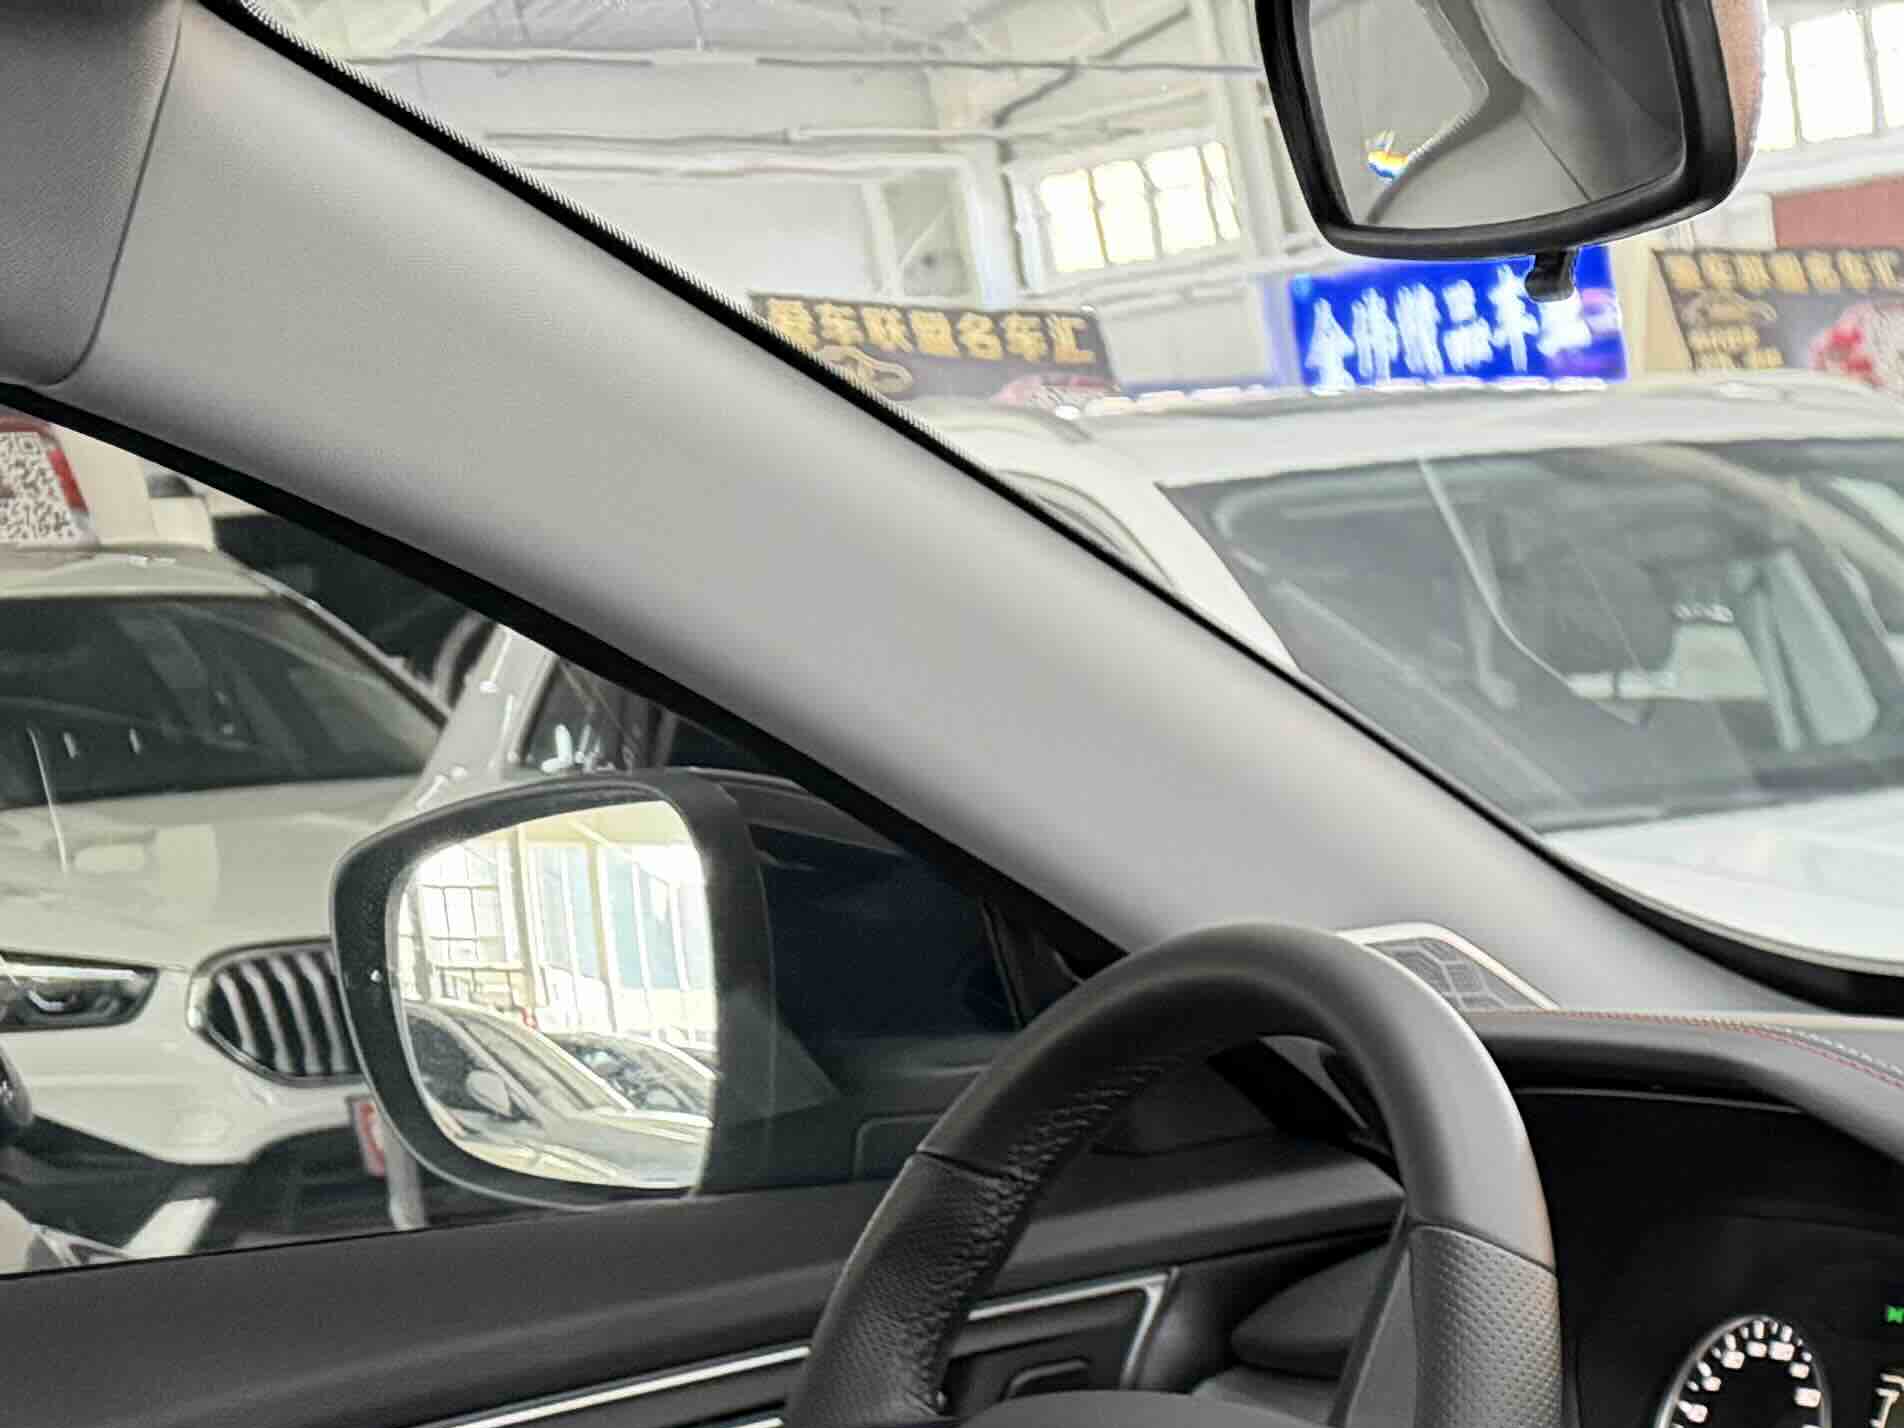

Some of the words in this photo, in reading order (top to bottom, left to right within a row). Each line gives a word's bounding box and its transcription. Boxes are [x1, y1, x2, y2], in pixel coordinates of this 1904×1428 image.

[767, 298, 1095, 363] 爱车联盟名车汇
